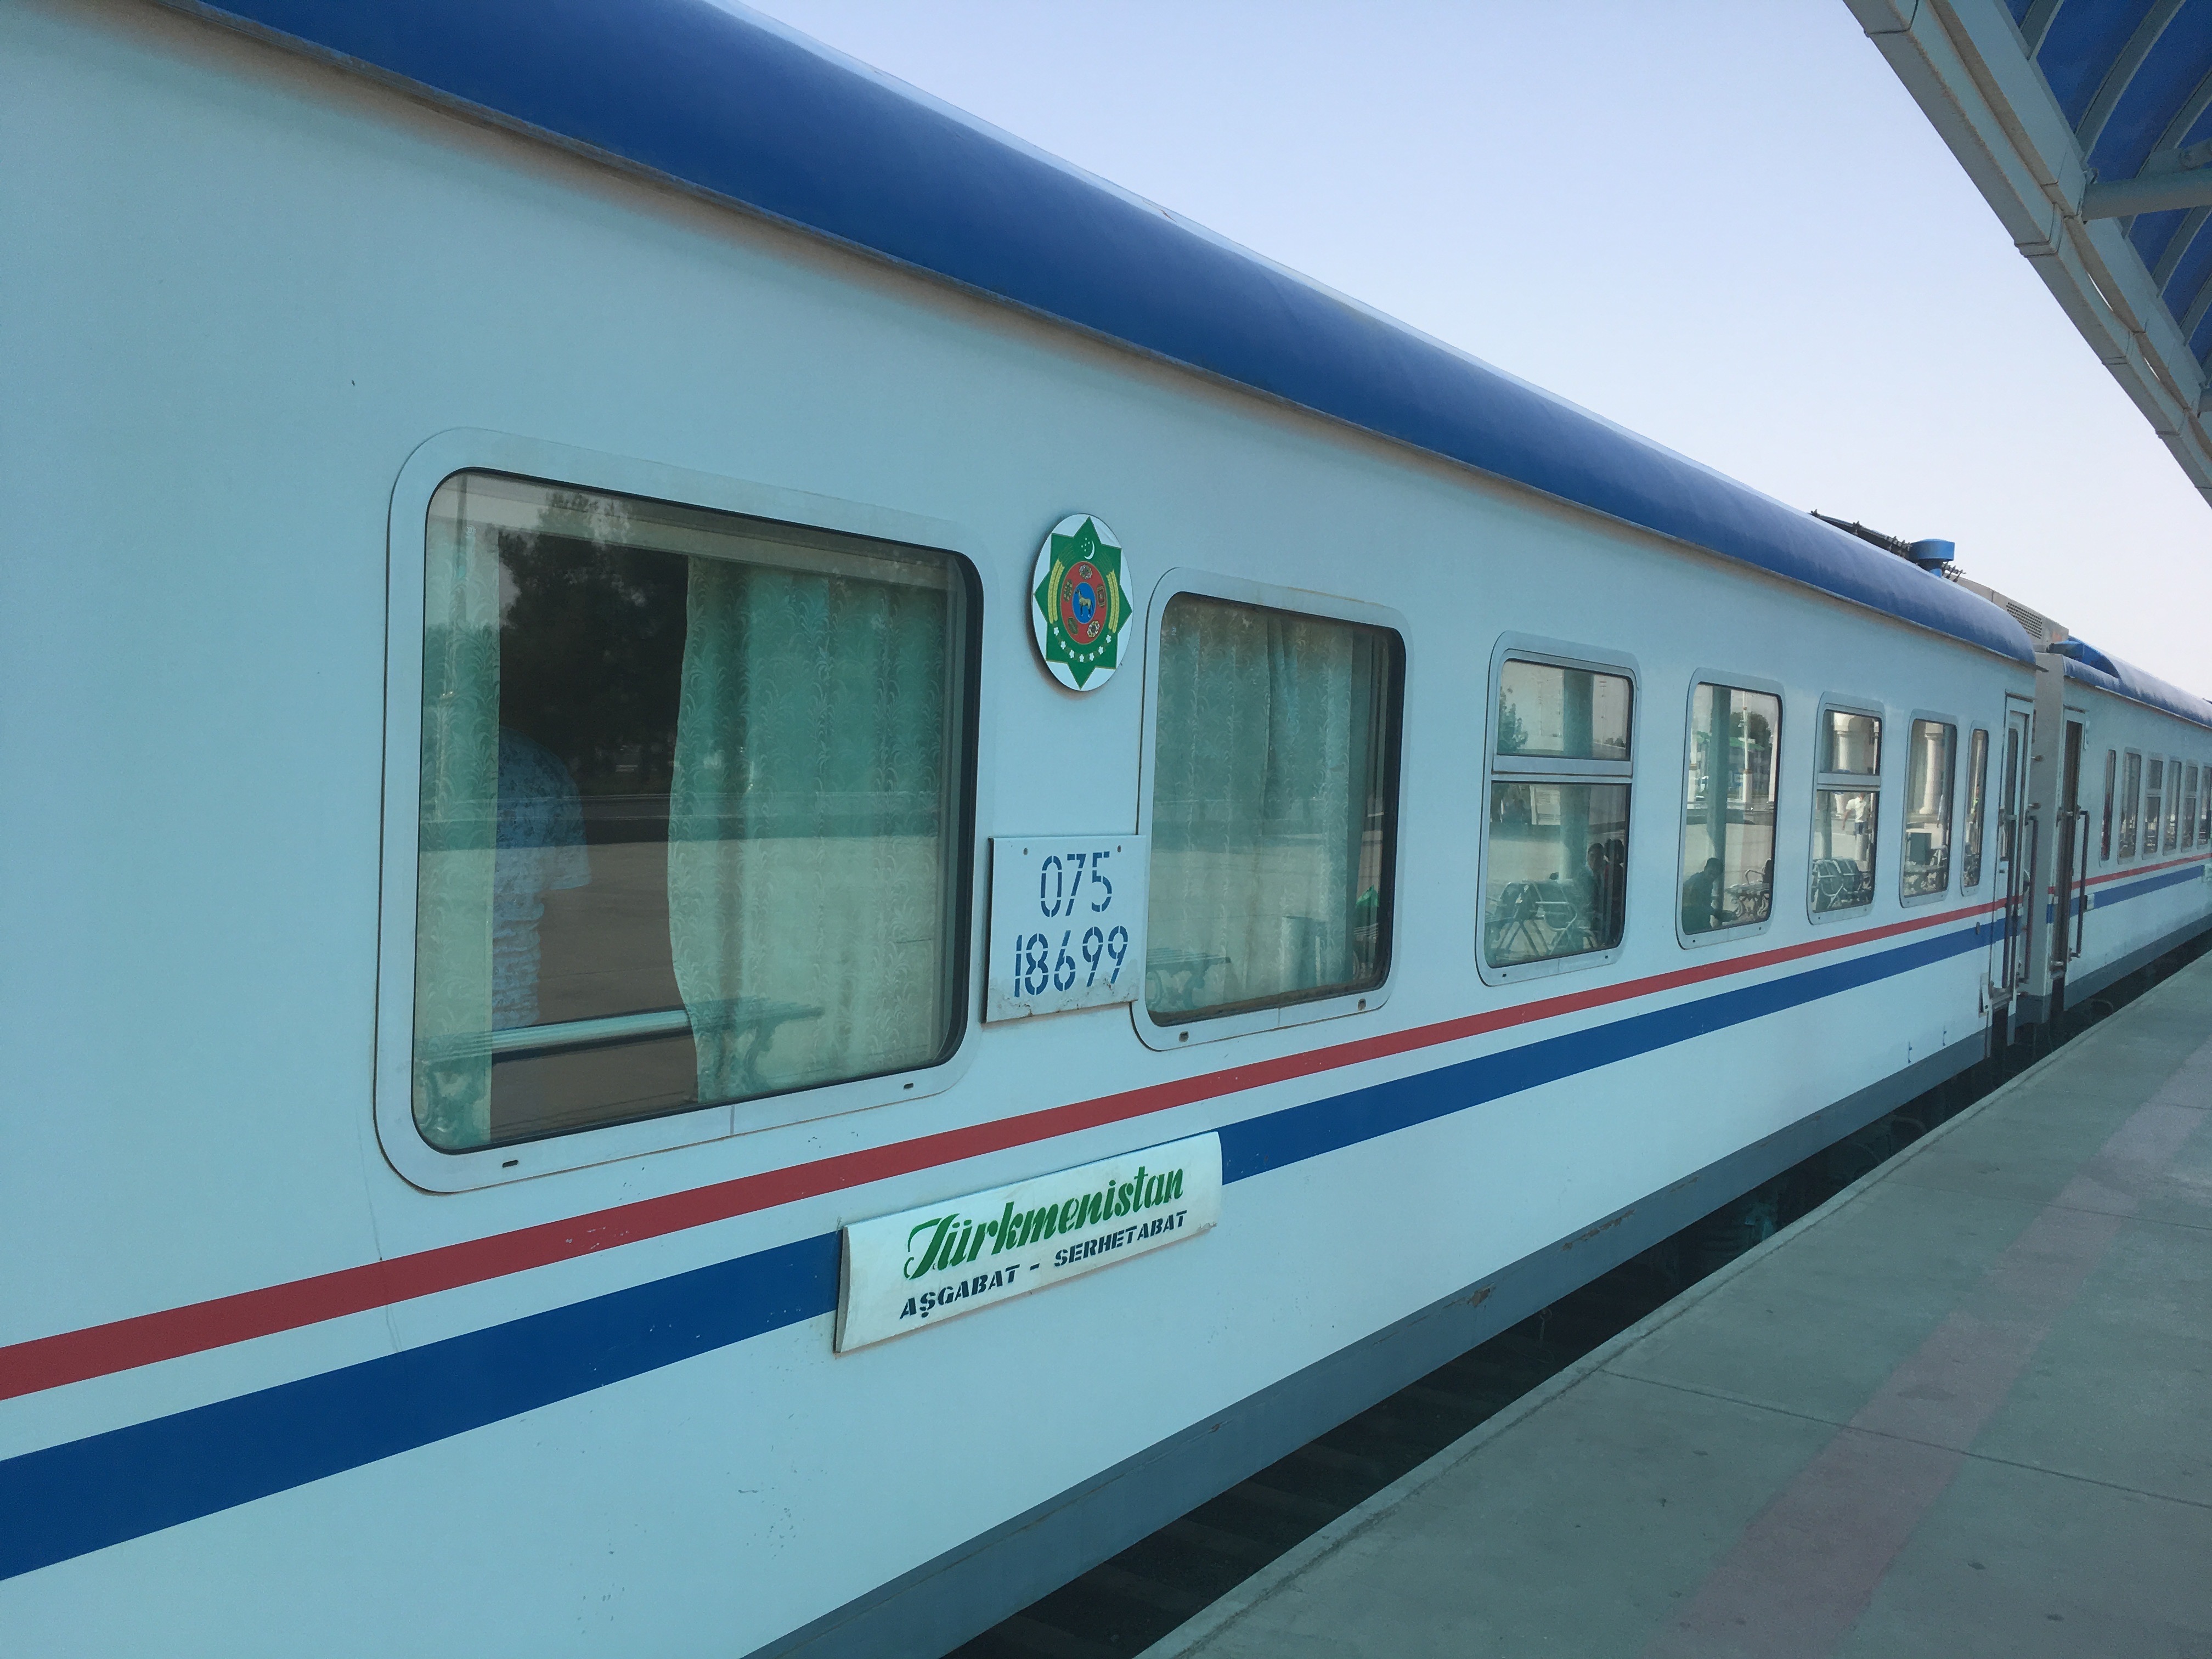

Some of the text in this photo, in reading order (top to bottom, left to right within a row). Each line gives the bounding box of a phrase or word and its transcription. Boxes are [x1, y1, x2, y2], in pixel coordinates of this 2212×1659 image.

[1040, 851, 1113, 918] 075
[1014, 926, 1128, 998] 18699
[899, 1264, 1020, 1319] AŞGABAT
[1053, 1210, 1187, 1267] SERHETABAT
[904, 1166, 1184, 1280] Türkmenistan
